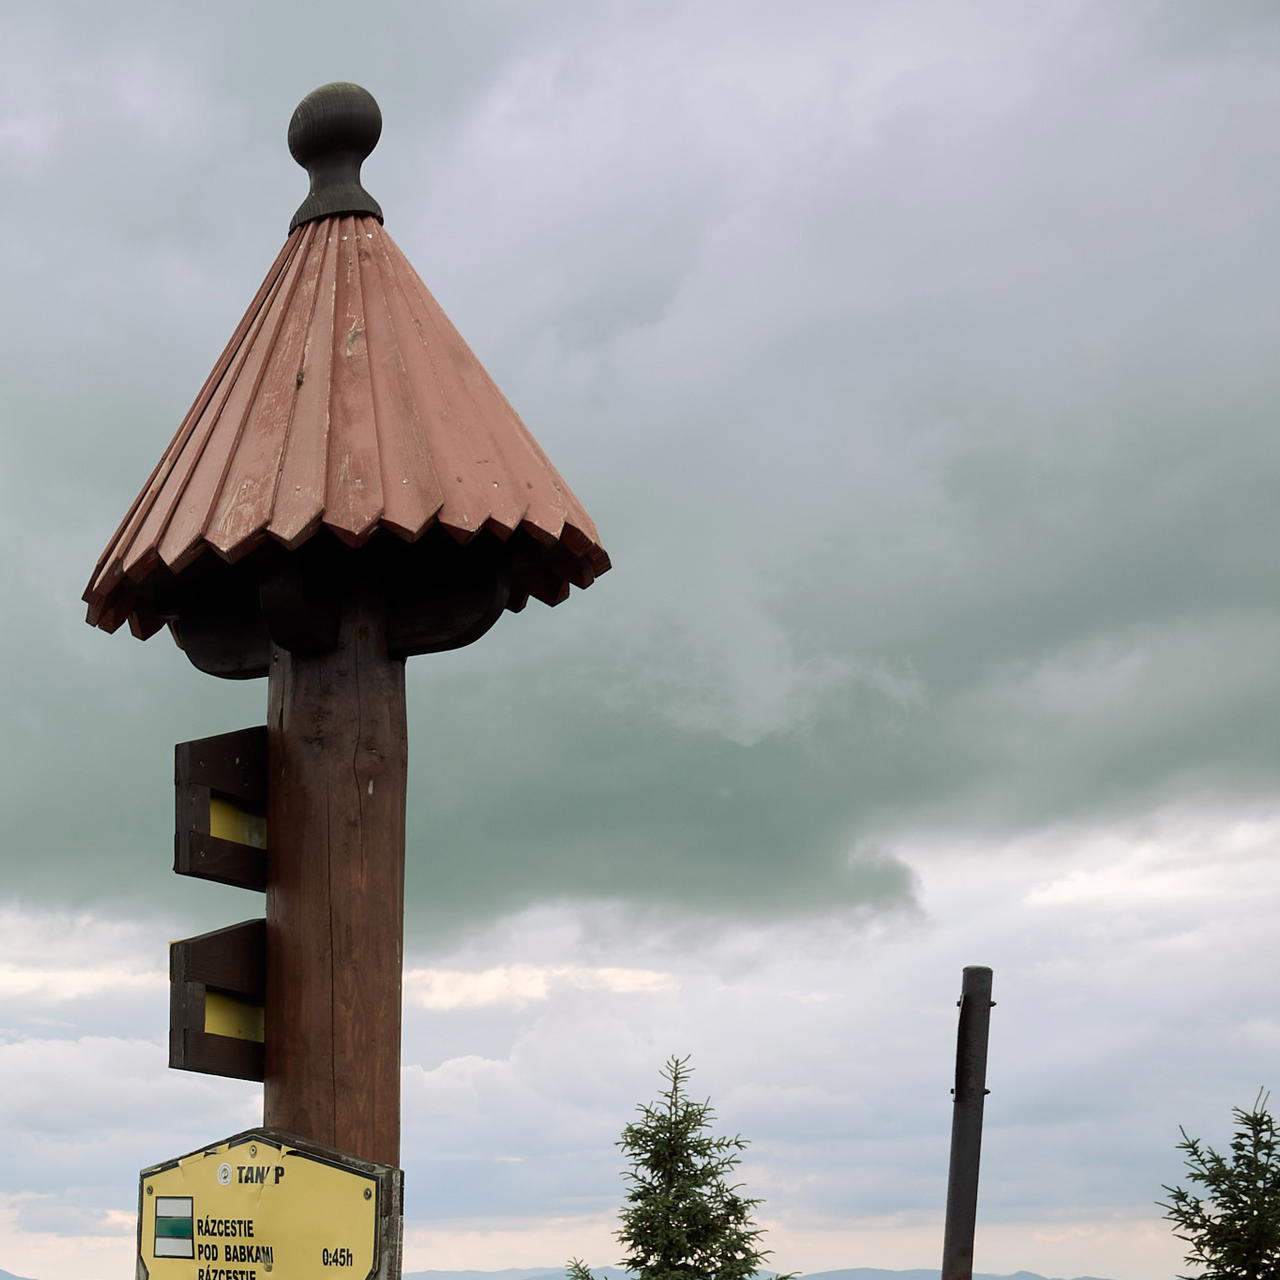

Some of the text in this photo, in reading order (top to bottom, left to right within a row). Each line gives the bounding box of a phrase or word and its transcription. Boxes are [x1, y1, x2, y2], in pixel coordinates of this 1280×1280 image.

[237, 1166, 284, 1184] TANP
[197, 1215, 254, 1238] RÁZCESTIE
[198, 1244, 352, 1266] POD BABKAMI 0:45h
